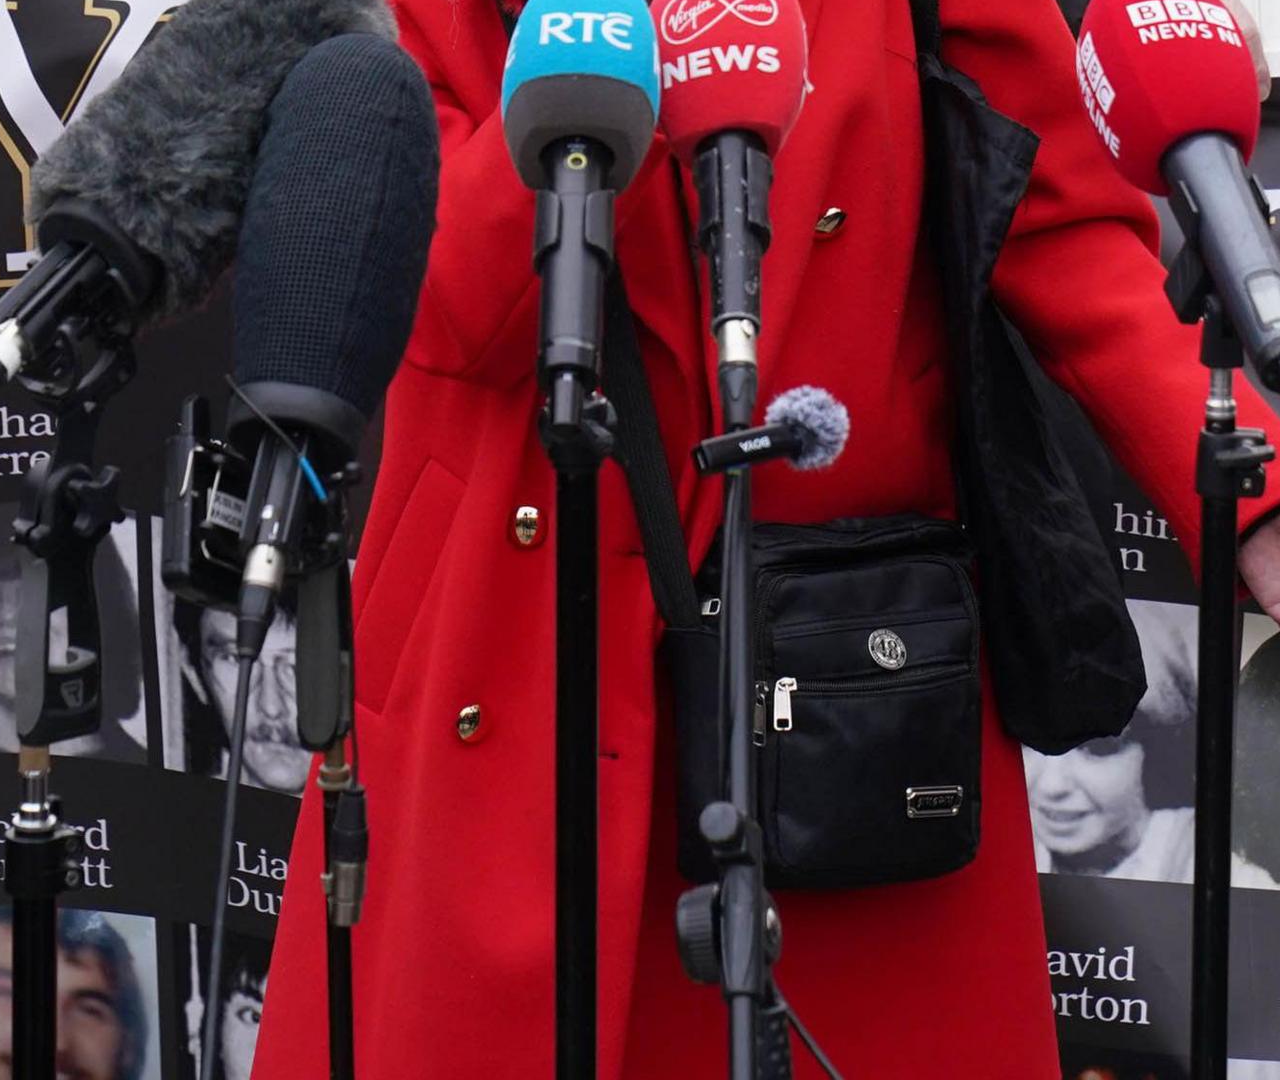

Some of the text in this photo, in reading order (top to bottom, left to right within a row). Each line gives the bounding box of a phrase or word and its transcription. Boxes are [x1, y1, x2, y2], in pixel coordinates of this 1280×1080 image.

[668, 0, 773, 34] Virgin media
[1130, 0, 1232, 28] BBC
[1138, 22, 1243, 49] NEWS NI
[662, 44, 781, 90] NEWS
[1081, 34, 1115, 111] BBC
[235, 840, 288, 881] Lia
[1046, 946, 1136, 981] avid
